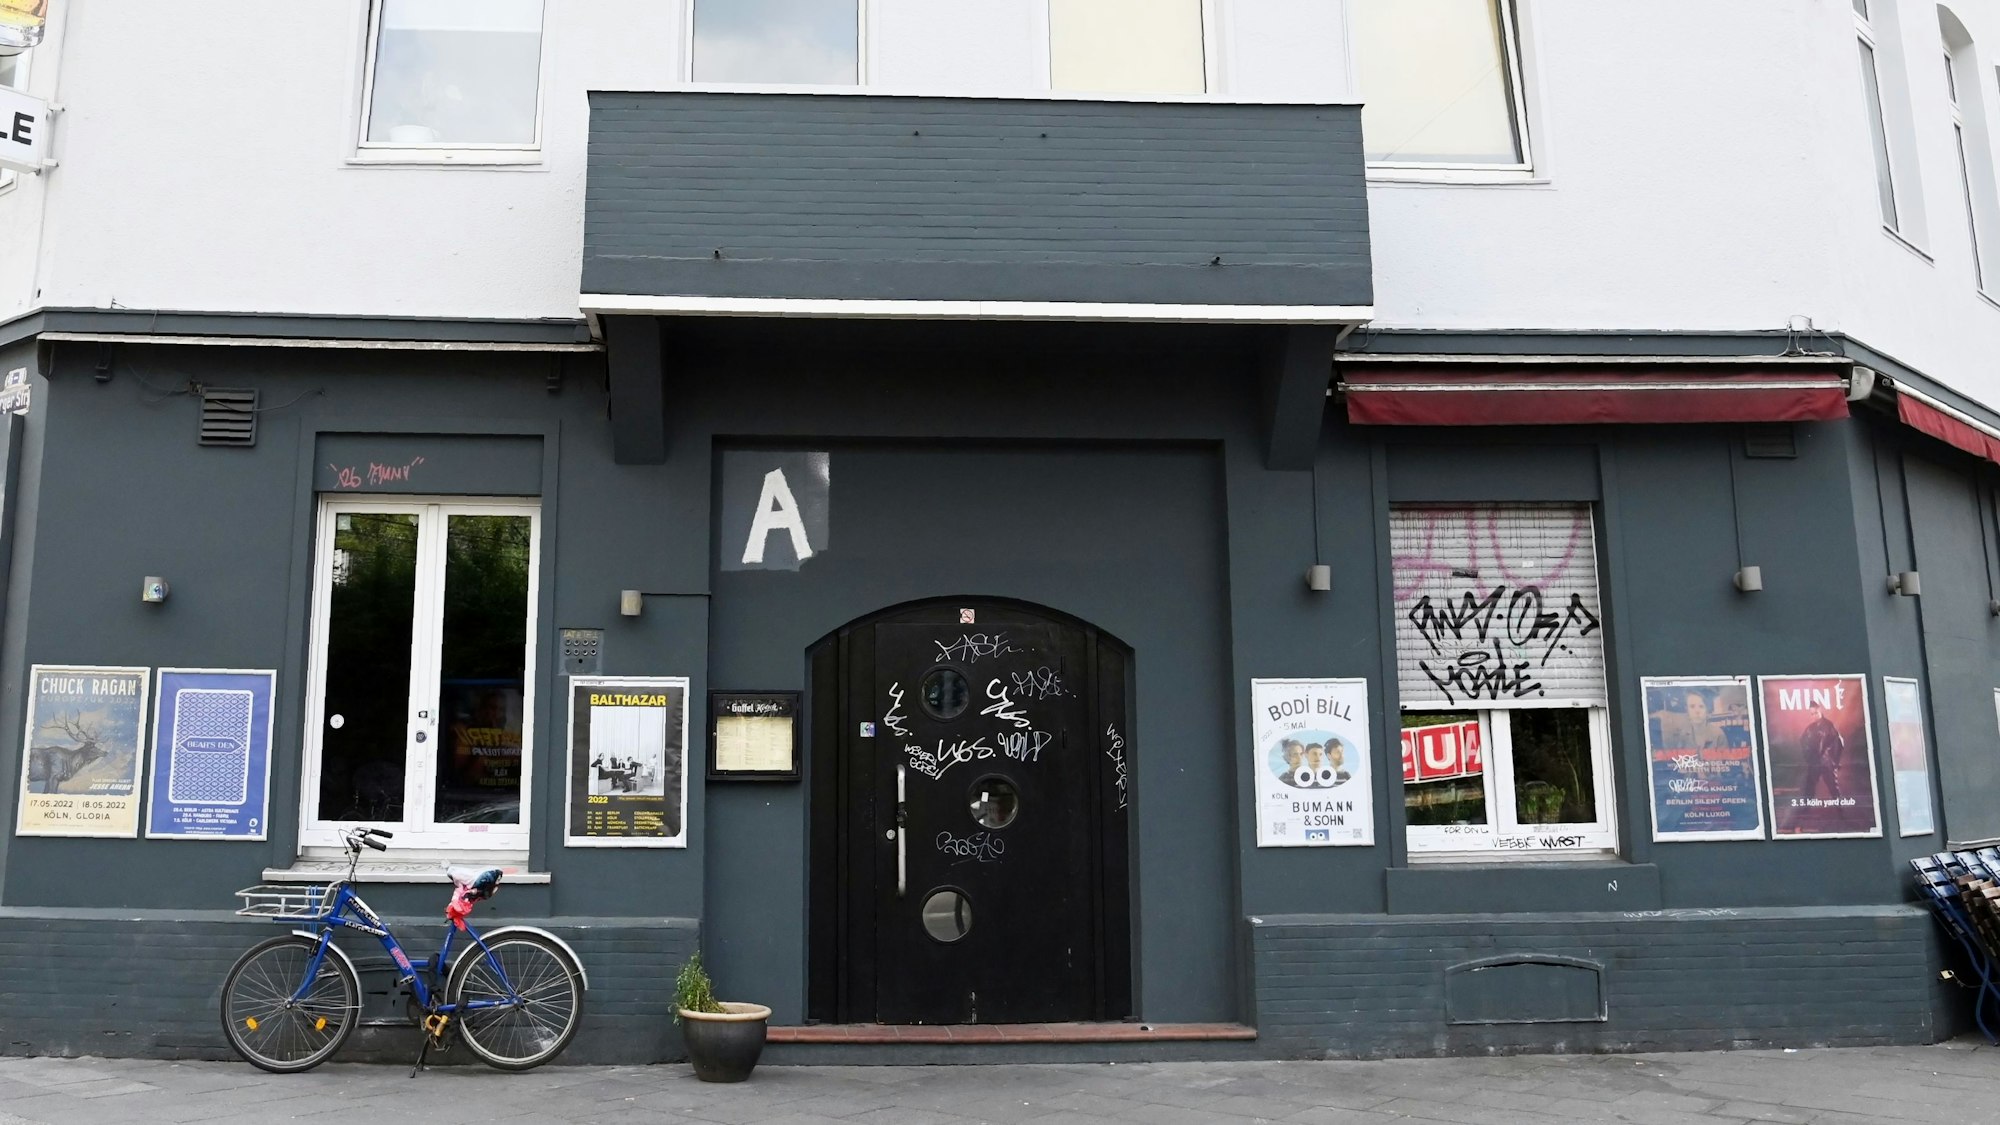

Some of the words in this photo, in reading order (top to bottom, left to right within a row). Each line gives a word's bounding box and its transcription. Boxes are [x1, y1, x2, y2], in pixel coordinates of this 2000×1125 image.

[741, 467, 813, 565] A
[42, 677, 84, 695] CHUCK
[92, 678, 137, 696] RAGAN
[590, 693, 667, 706] BALTHAZAR
[187, 740, 216, 748] BEAR'S
[217, 741, 235, 749] DEN
[30, 800, 74, 808] 17.05.2022
[82, 801, 126, 809] 18.05.2022
[587, 796, 608, 804] 2022
[1806, 797, 1823, 806] köln
[1823, 797, 1840, 808] yard
[1840, 797, 1856, 806] club
[1292, 801, 1353, 813] BUMANN
[44, 810, 72, 820] KÖLN,
[76, 812, 110, 821] GLORIA
[1304, 815, 1312, 827] &
[1314, 814, 1344, 827] SOHN
[1539, 835, 1586, 850] WURST
